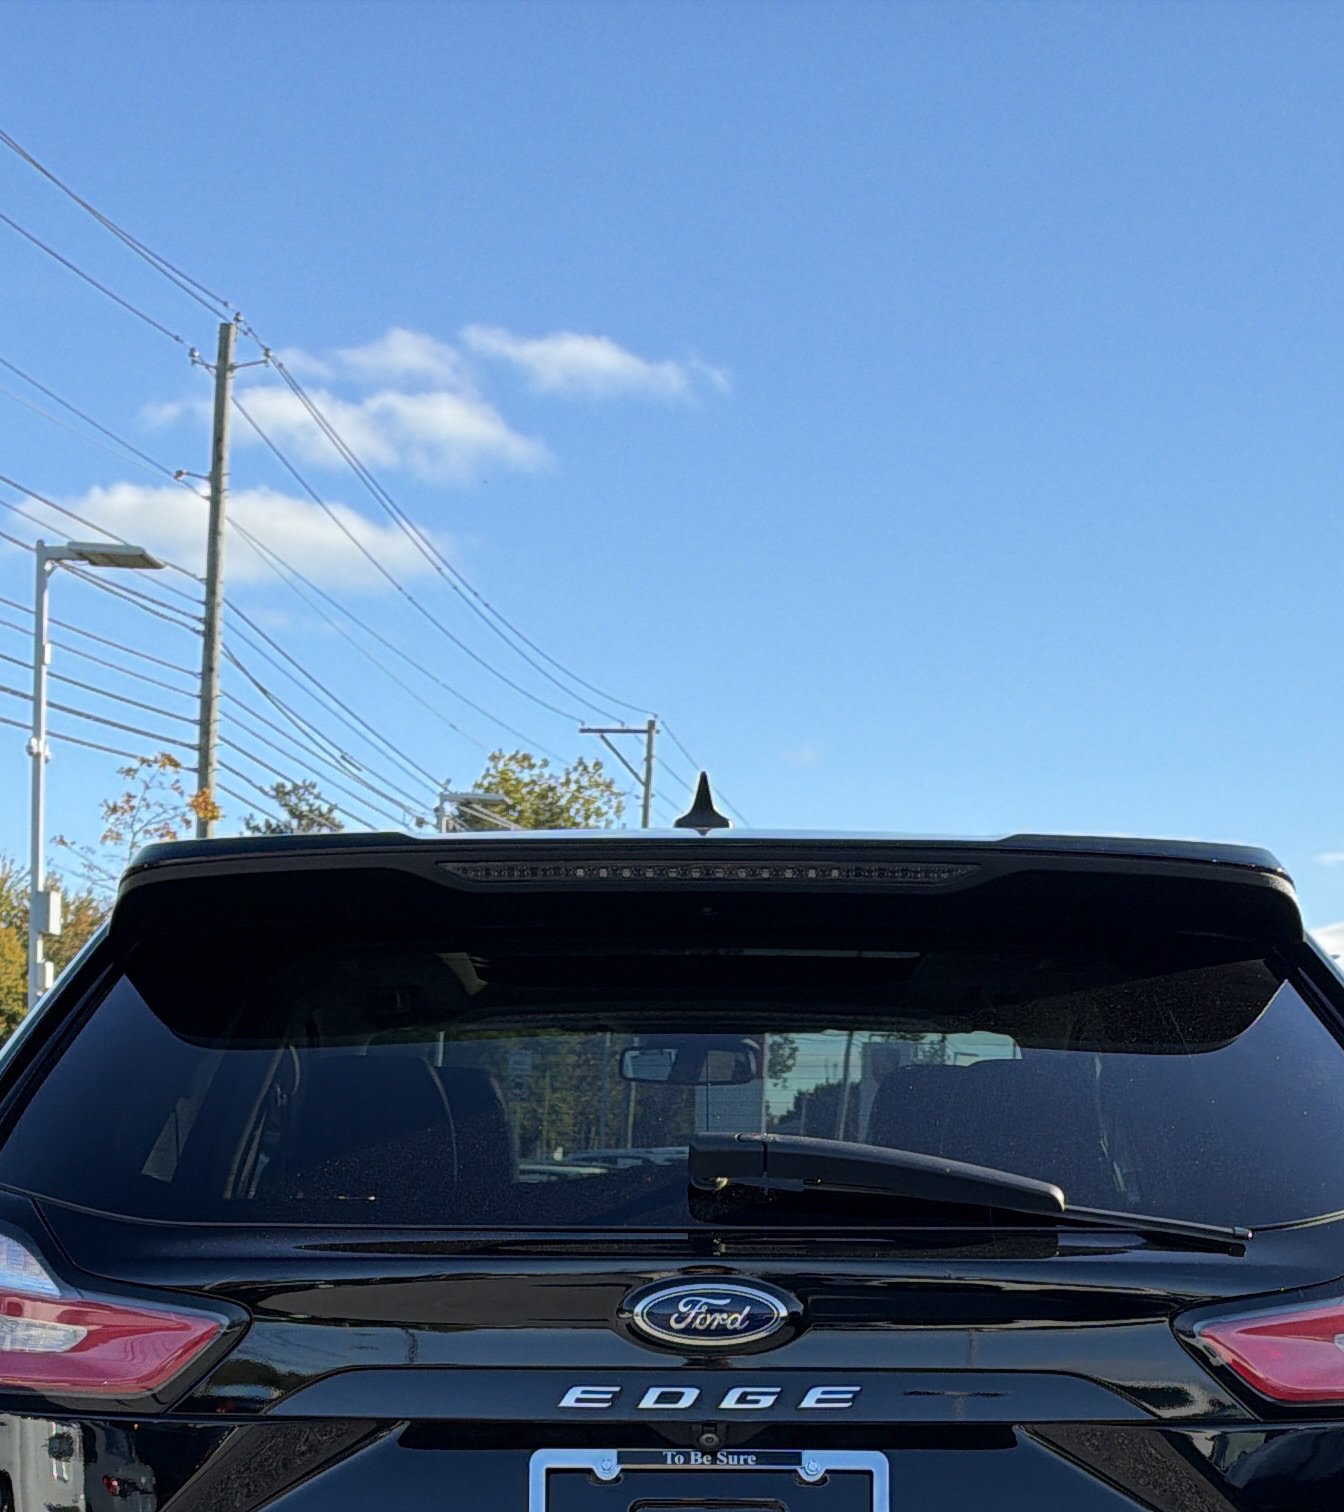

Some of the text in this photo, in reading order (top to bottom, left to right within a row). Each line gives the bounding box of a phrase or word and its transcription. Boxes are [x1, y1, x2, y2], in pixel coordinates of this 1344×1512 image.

[669, 1296, 751, 1330] Ford
[557, 1386, 862, 1409] EDGE
[662, 1451, 757, 1466] To Be Sure
